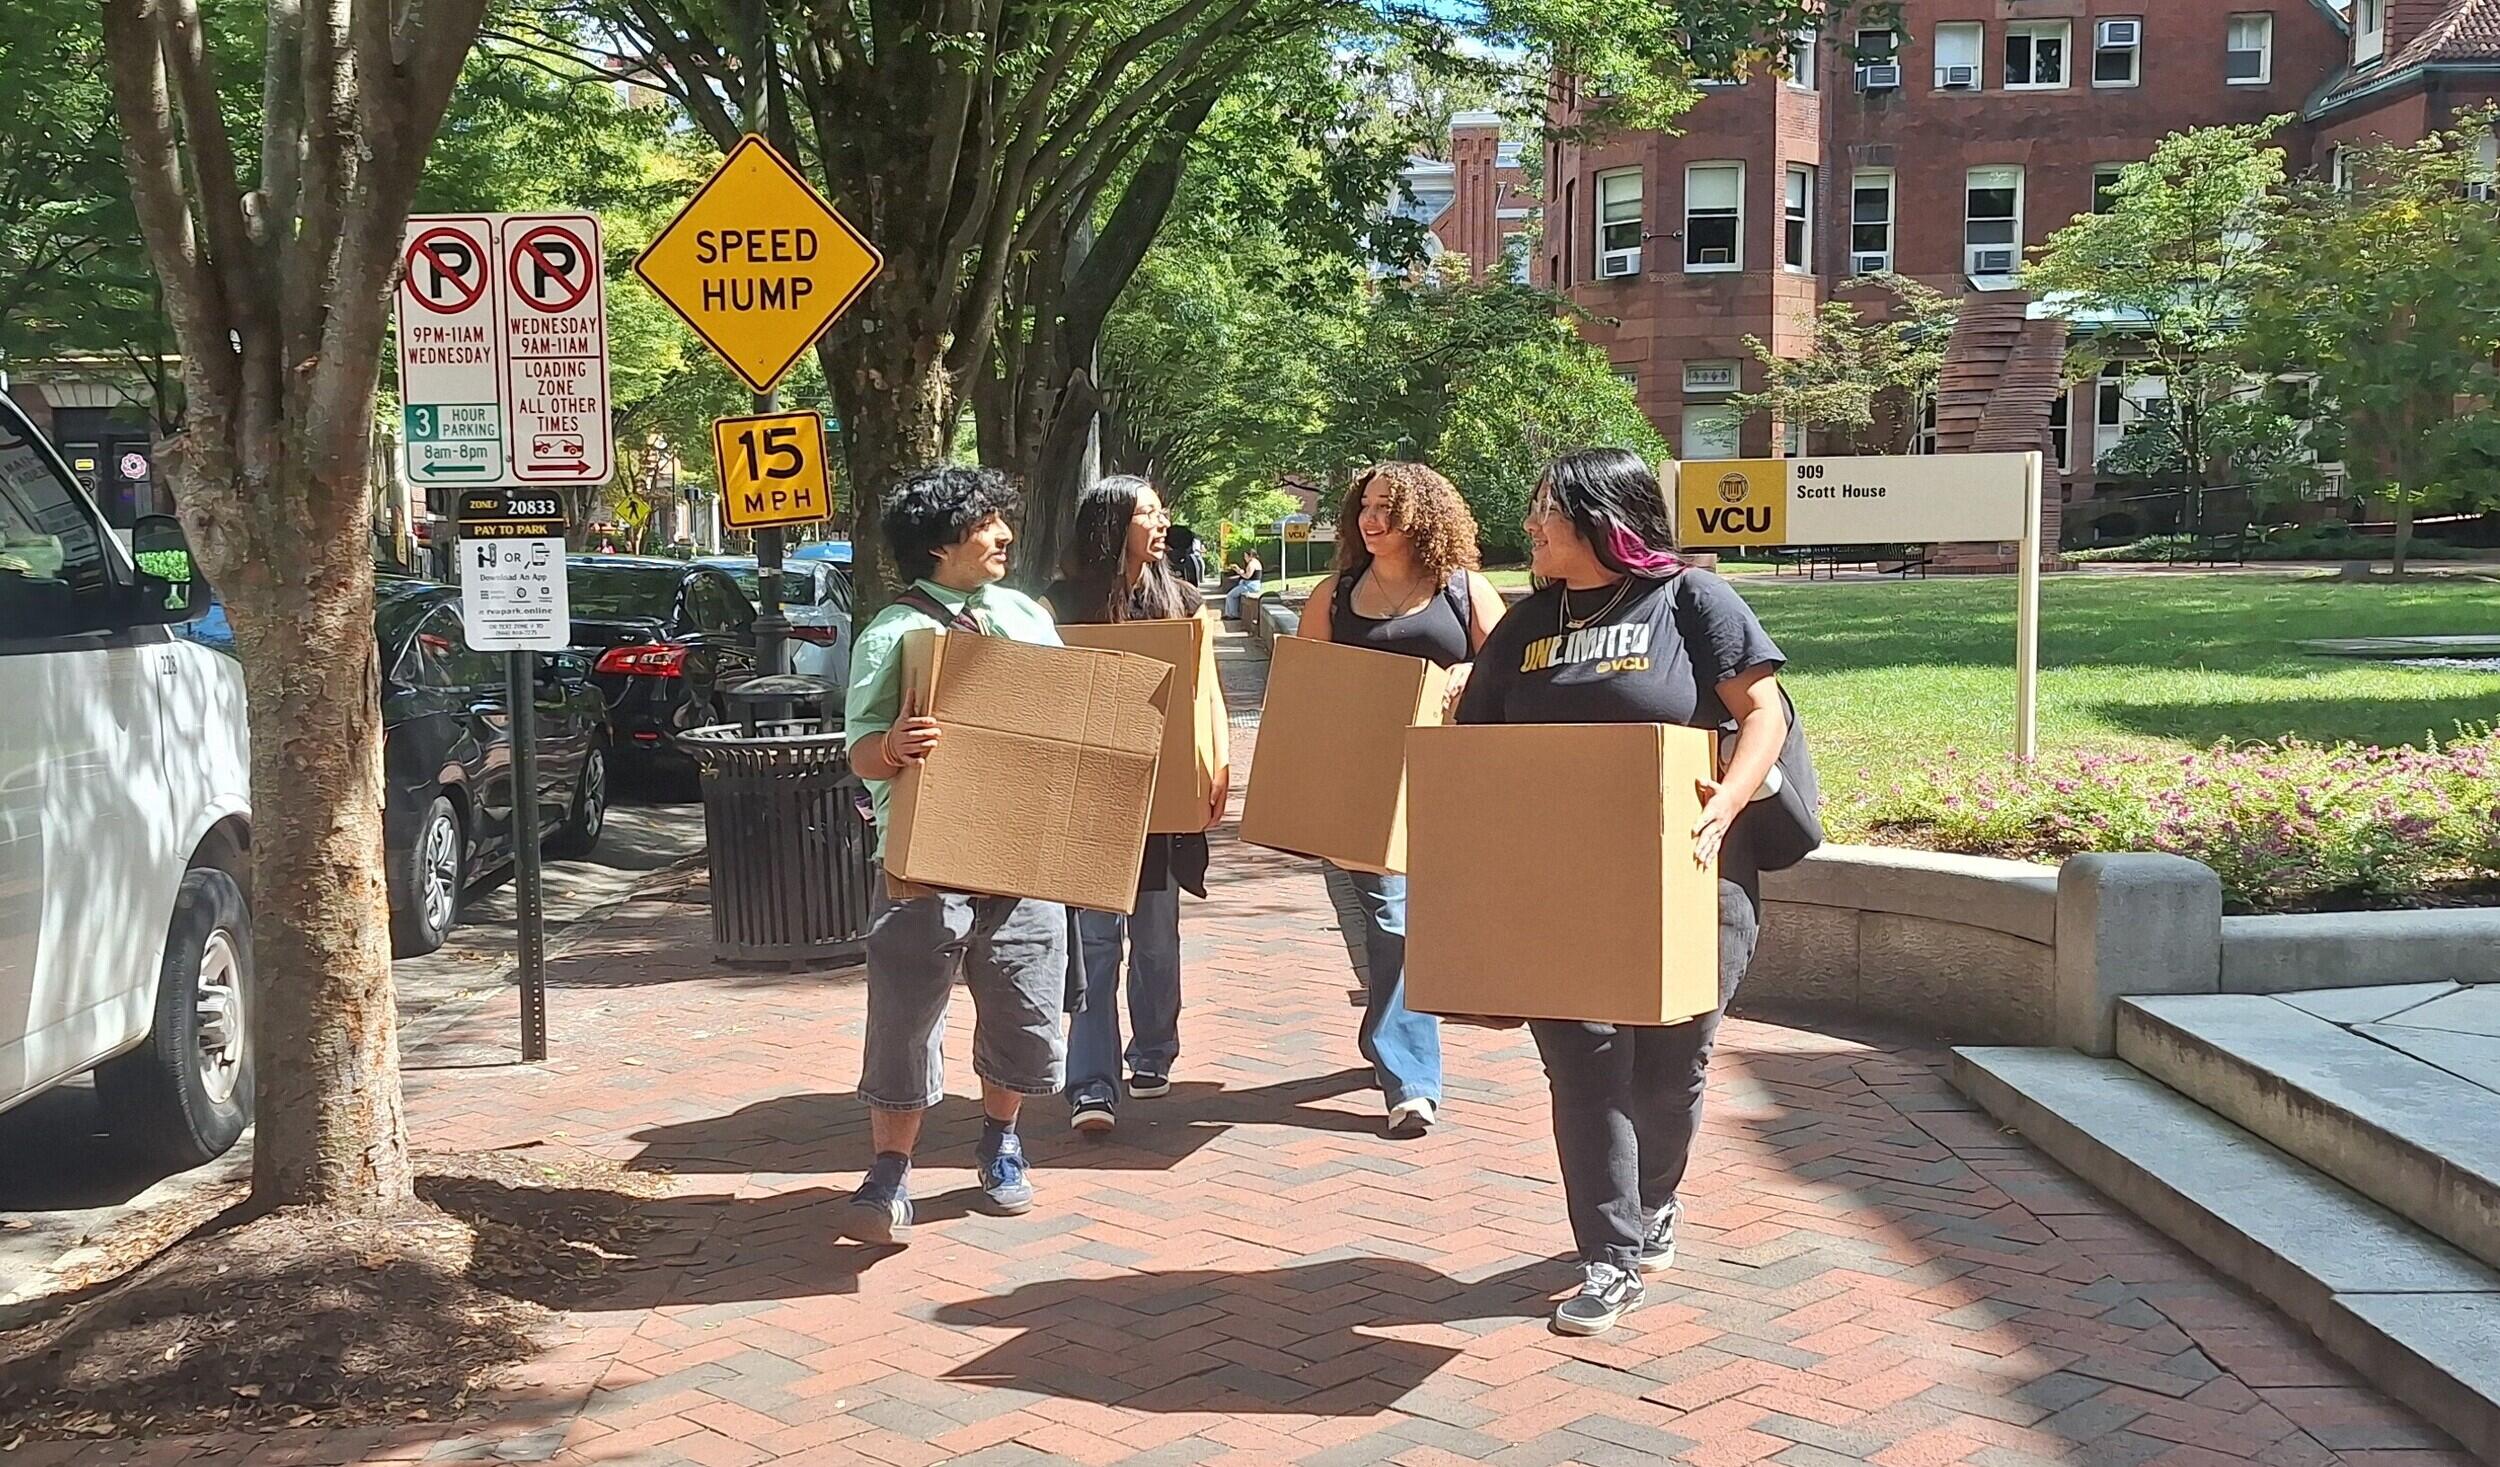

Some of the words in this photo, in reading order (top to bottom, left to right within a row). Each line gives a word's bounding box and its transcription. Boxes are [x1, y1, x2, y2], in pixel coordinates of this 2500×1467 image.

[696, 228, 818, 263] SPEED
[702, 277, 813, 312] HUMP
[511, 317, 597, 335] WEDNESDAY
[413, 326, 484, 343] 9PM-11AM
[521, 338, 588, 353] 9AM-11AM
[408, 347, 491, 364] WEDNESDAY
[525, 361, 586, 378] LOADING
[537, 380, 574, 396] ZONE
[519, 398, 546, 414] ALL
[551, 398, 596, 413] OTHER
[414, 408, 432, 438] 3
[452, 408, 485, 422] HOUR
[442, 422, 495, 437] PARKING
[537, 416, 579, 432] TIMES
[424, 444, 488, 461] 8am-8pm
[737, 427, 802, 482] 15
[1796, 465, 1824, 480] 909
[1796, 484, 1836, 499] Scott
[1842, 484, 1886, 499] House
[507, 500, 556, 515] 20833
[745, 487, 811, 513] MPH
[1695, 506, 1772, 534] VCU
[474, 525, 496, 535] PAY
[499, 525, 514, 535] TO
[516, 524, 548, 535] PARK
[1288, 531, 1306, 539] VCU
[504, 552, 522, 563] OR
[1520, 623, 1650, 673] UNLIMITED
[1611, 656, 1650, 671] VCU
